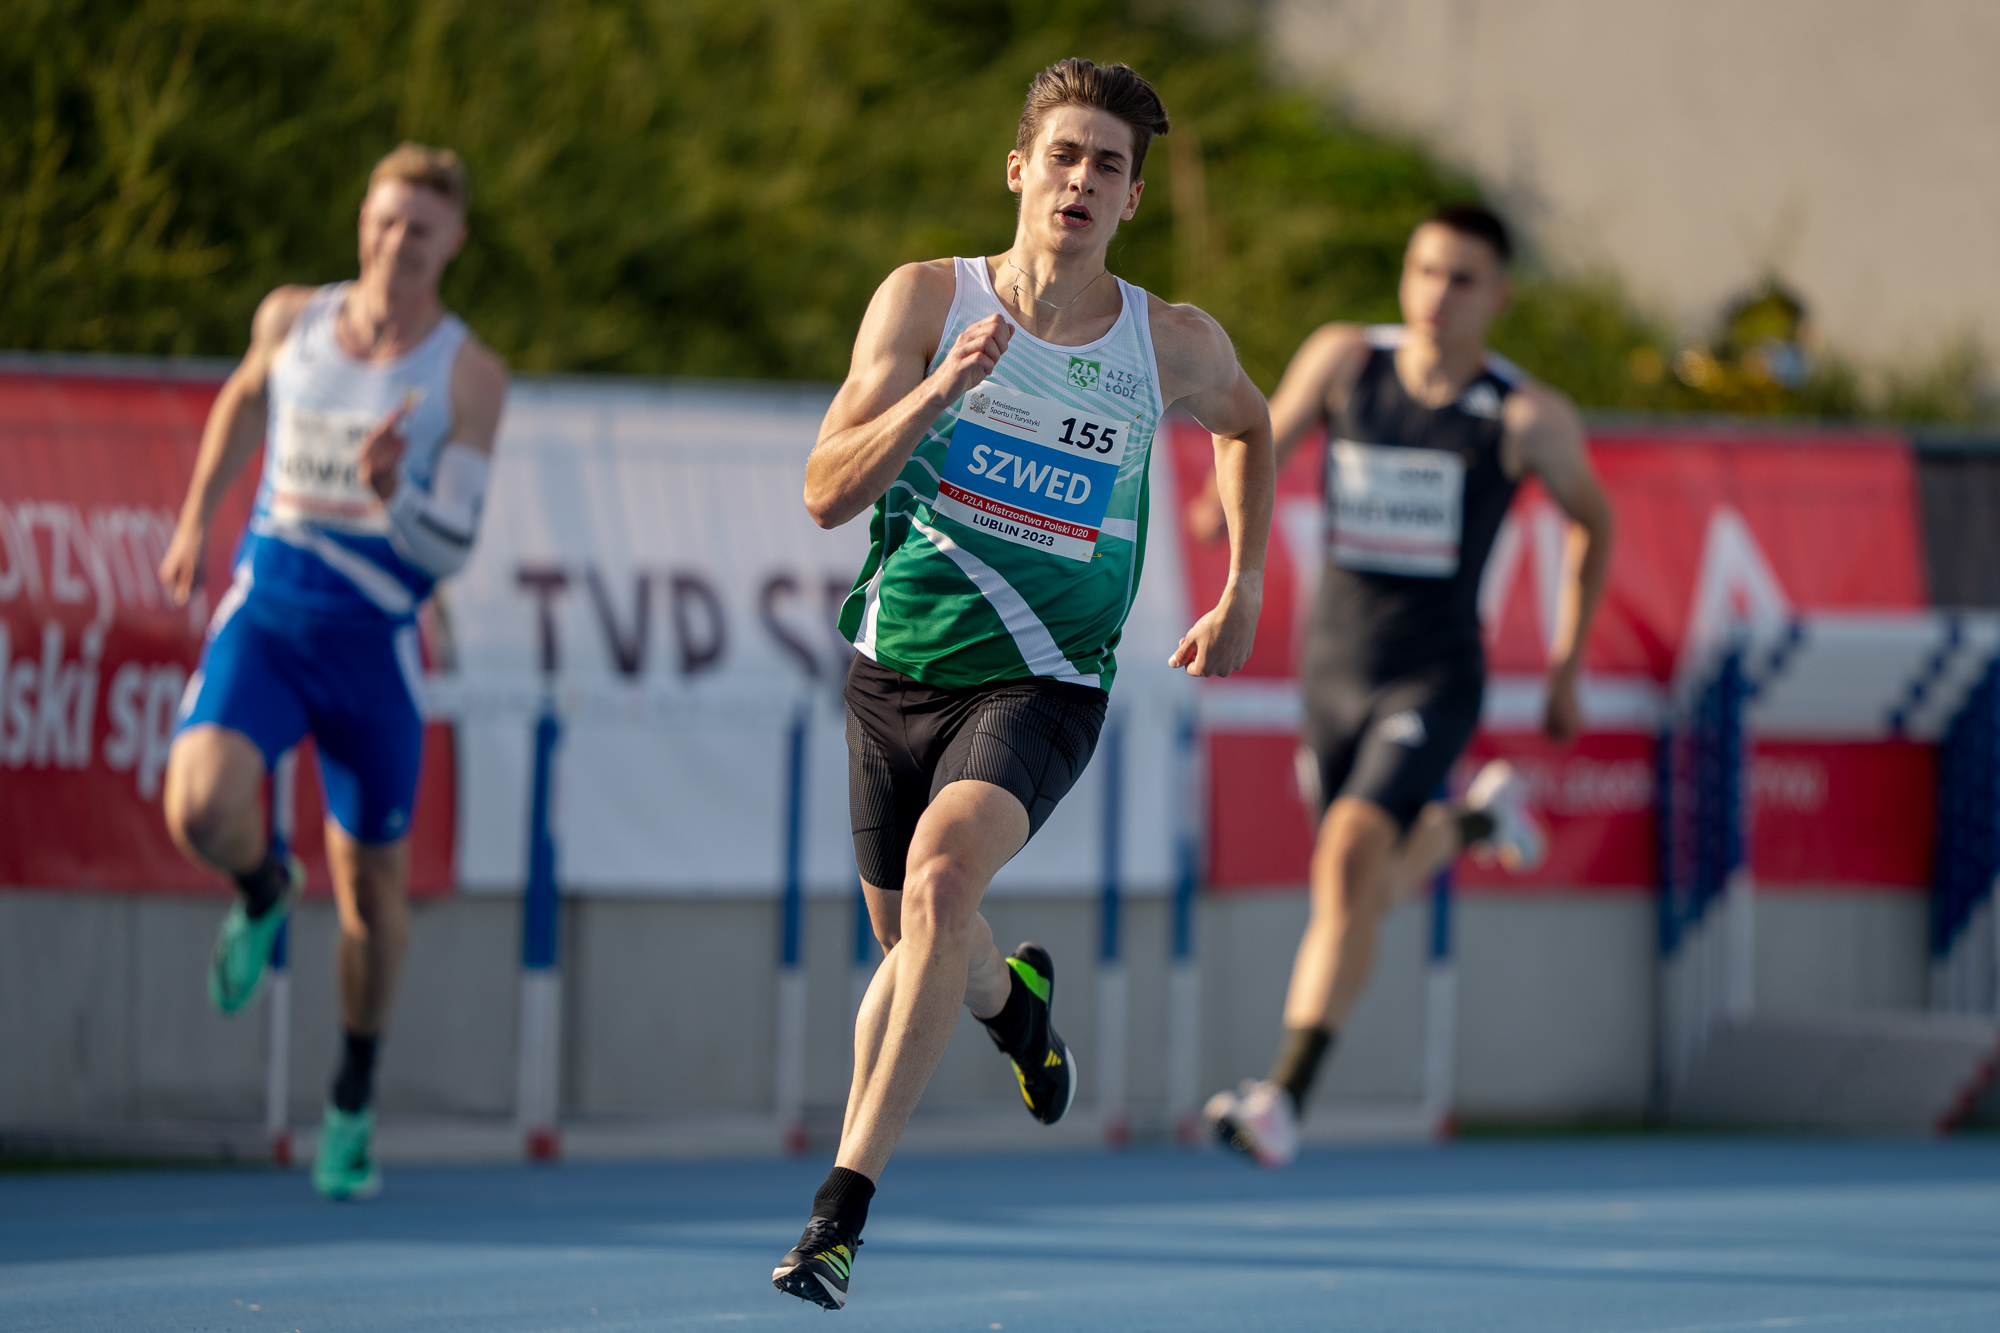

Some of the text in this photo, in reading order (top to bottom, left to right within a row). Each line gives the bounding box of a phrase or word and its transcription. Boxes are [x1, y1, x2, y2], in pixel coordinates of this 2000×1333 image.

[1106, 369, 1133, 385] AZS
[989, 406, 1010, 418] Sportu
[1014, 413, 1041, 427] Turystyki
[992, 399, 1031, 416] Ministerstwo
[1058, 417, 1117, 454] 155
[967, 444, 1092, 505] SZWED
[949, 487, 1089, 539] 77. PZLA Mistrzostwa Polski U20
[972, 513, 1055, 547] LUBLIN 2023
